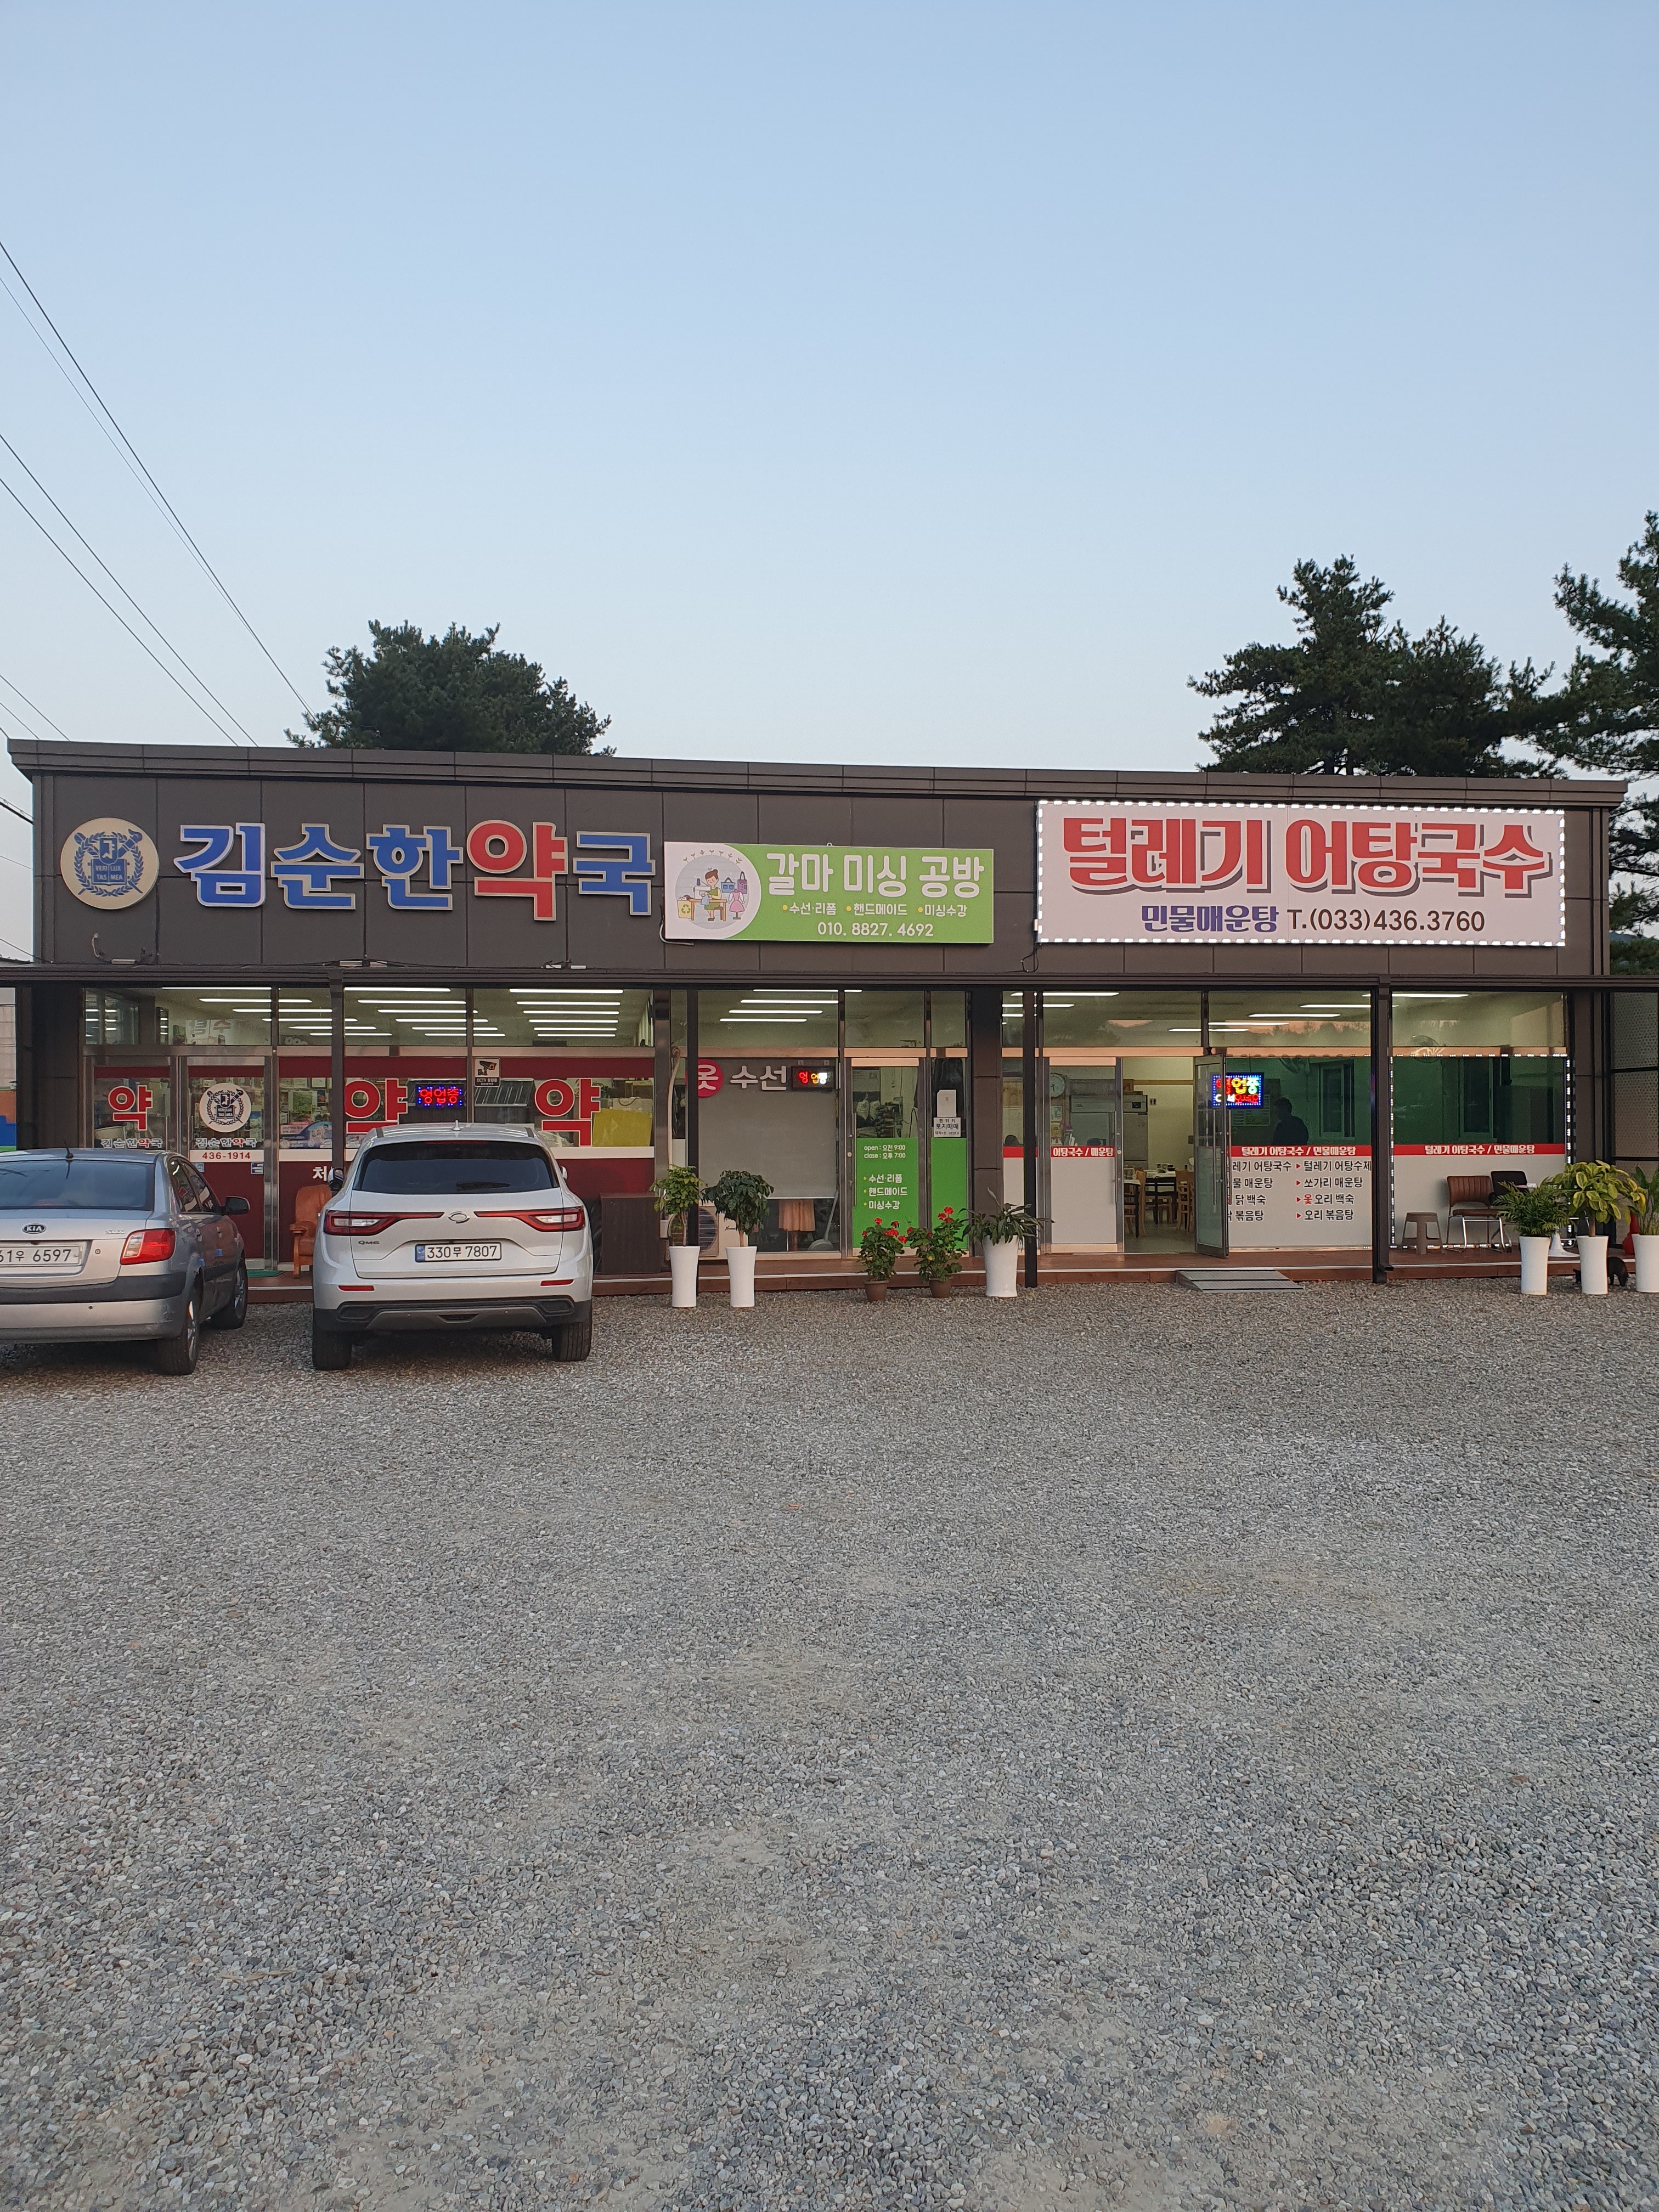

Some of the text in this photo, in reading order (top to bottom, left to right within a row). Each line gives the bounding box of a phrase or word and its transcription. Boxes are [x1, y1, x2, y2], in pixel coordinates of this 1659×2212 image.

[1063, 817, 1554, 899] 털레기 어탕국수
[173, 820, 656, 921] 김순한약국
[766, 853, 985, 899] 갈마 미싱 공방
[854, 902, 908, 916] 핸드메이드
[924, 904, 968, 918] 미싱수강
[1142, 905, 1279, 933] 민물매운탕
[817, 922, 934, 937] 010. 8827. 4692
[730, 1065, 787, 1091] 수선
[419, 1088, 459, 1104] 영업중
[108, 1085, 153, 1131] 약
[534, 1078, 601, 1147] 약
[100, 1138, 163, 1149] 김순한약국
[195, 1137, 257, 1148] 김순한약국
[1053, 1147, 1084, 1156] 어탕국수
[1091, 1147, 1114, 1156] 매운탕
[1241, 1147, 1268, 1156] 털레기
[1269, 1147, 1304, 1156] 어탕국수
[1313, 1146, 1357, 1156] 민물매운탕
[1425, 1145, 1450, 1155] 털레기
[1452, 1145, 1486, 1155] 어탕국수
[1227, 1161, 1292, 1172] 레기 어탕국수
[1304, 1160, 1331, 1171] 털레기
[1227, 1178, 1273, 1189] 물 매운탕
[1304, 1177, 1363, 1188] 쏘가리 매운탕
[868, 1187, 908, 1197] 핸드메이드
[1246, 1194, 1266, 1205] 백숙
[1335, 1193, 1355, 1204] 백숙
[868, 1200, 900, 1210] 미싱수강
[1235, 1210, 1264, 1222] 볶음탕
[1304, 1209, 1354, 1221] 오리 볶음탕
[32, 1249, 72, 1262] 6597
[427, 1245, 498, 1259] 330무 7807
